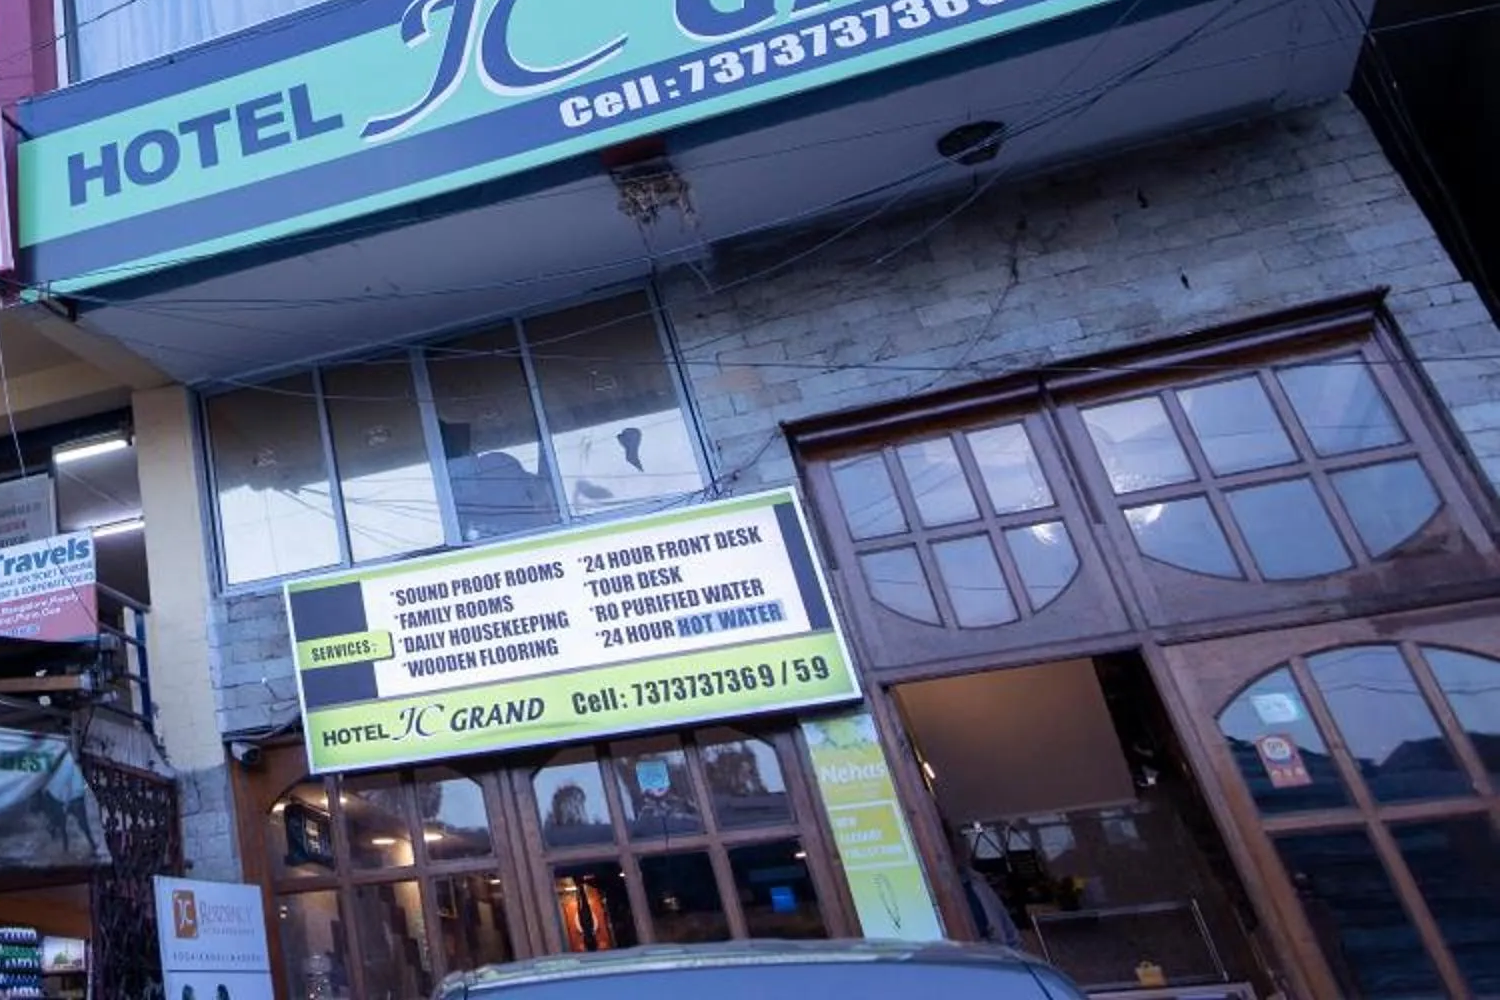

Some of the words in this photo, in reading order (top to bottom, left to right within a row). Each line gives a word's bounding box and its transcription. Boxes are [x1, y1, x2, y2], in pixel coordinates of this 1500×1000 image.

[66, 82, 345, 207] HOTEL
[583, 553, 605, 574] 24
[607, 544, 656, 570] HOUR
[656, 533, 711, 562] FRONT
[714, 525, 763, 550] DESK
[395, 582, 449, 607] SOUND
[451, 573, 502, 597] PROOF
[504, 561, 565, 587] ROOMS
[588, 574, 635, 598] TOUR
[637, 565, 684, 590] DESK
[594, 602, 620, 623] RO
[621, 588, 701, 620] PURIFIED
[700, 577, 765, 605] WATER
[400, 605, 451, 631] FAMILY
[455, 595, 515, 621] ROOMS
[403, 631, 445, 654] DAILY
[448, 610, 570, 647] HOUSEKEEPING
[601, 627, 624, 649] 24
[625, 618, 675, 645] HOUR
[676, 614, 715, 638] HOT
[717, 602, 785, 631] WATER
[407, 651, 478, 679] WOODEN
[479, 637, 560, 668] FLOORING
[631, 662, 776, 708] 7373737369
[792, 655, 831, 684] 59
[322, 722, 390, 747] HOTEL
[389, 702, 445, 742] JC
[449, 697, 546, 733] GRAND
